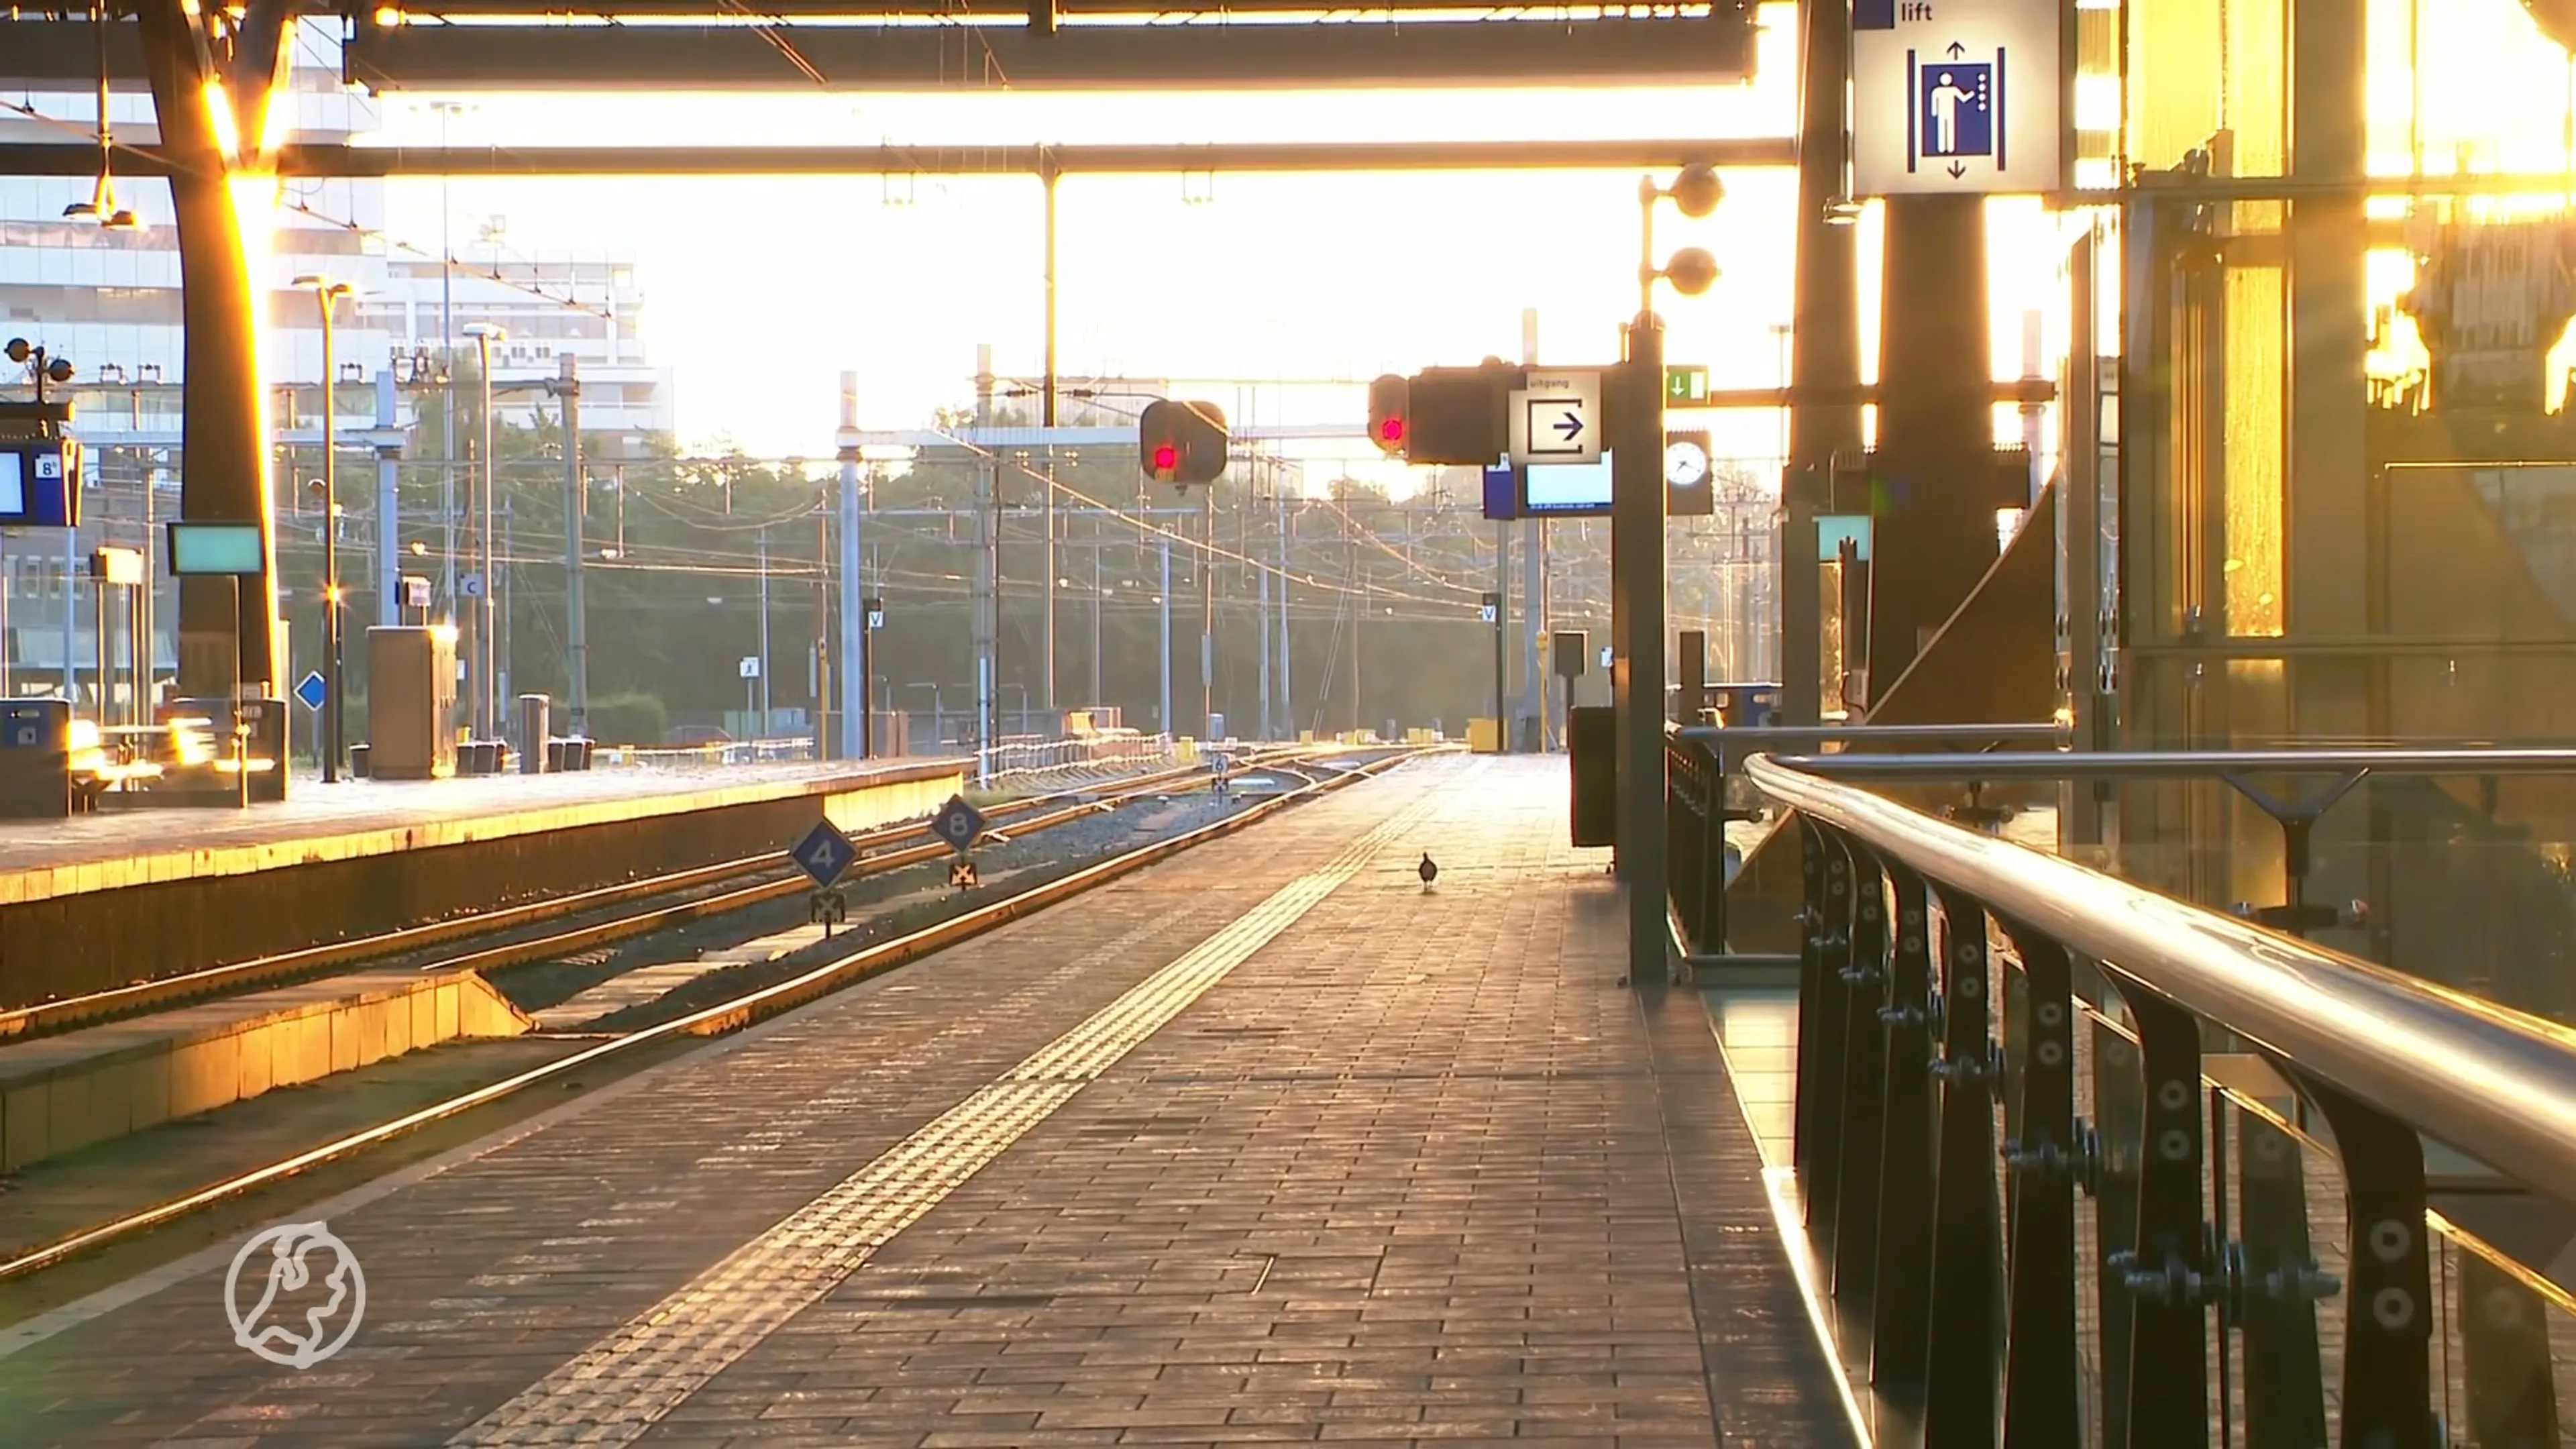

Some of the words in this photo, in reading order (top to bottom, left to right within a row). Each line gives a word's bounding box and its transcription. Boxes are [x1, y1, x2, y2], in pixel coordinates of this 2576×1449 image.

[1902, 2, 1933, 21] lift
[1529, 379, 1570, 390] uitgang
[871, 613, 881, 625] V
[1484, 608, 1494, 619] V
[949, 812, 968, 837] 8
[810, 840, 835, 868] 4
